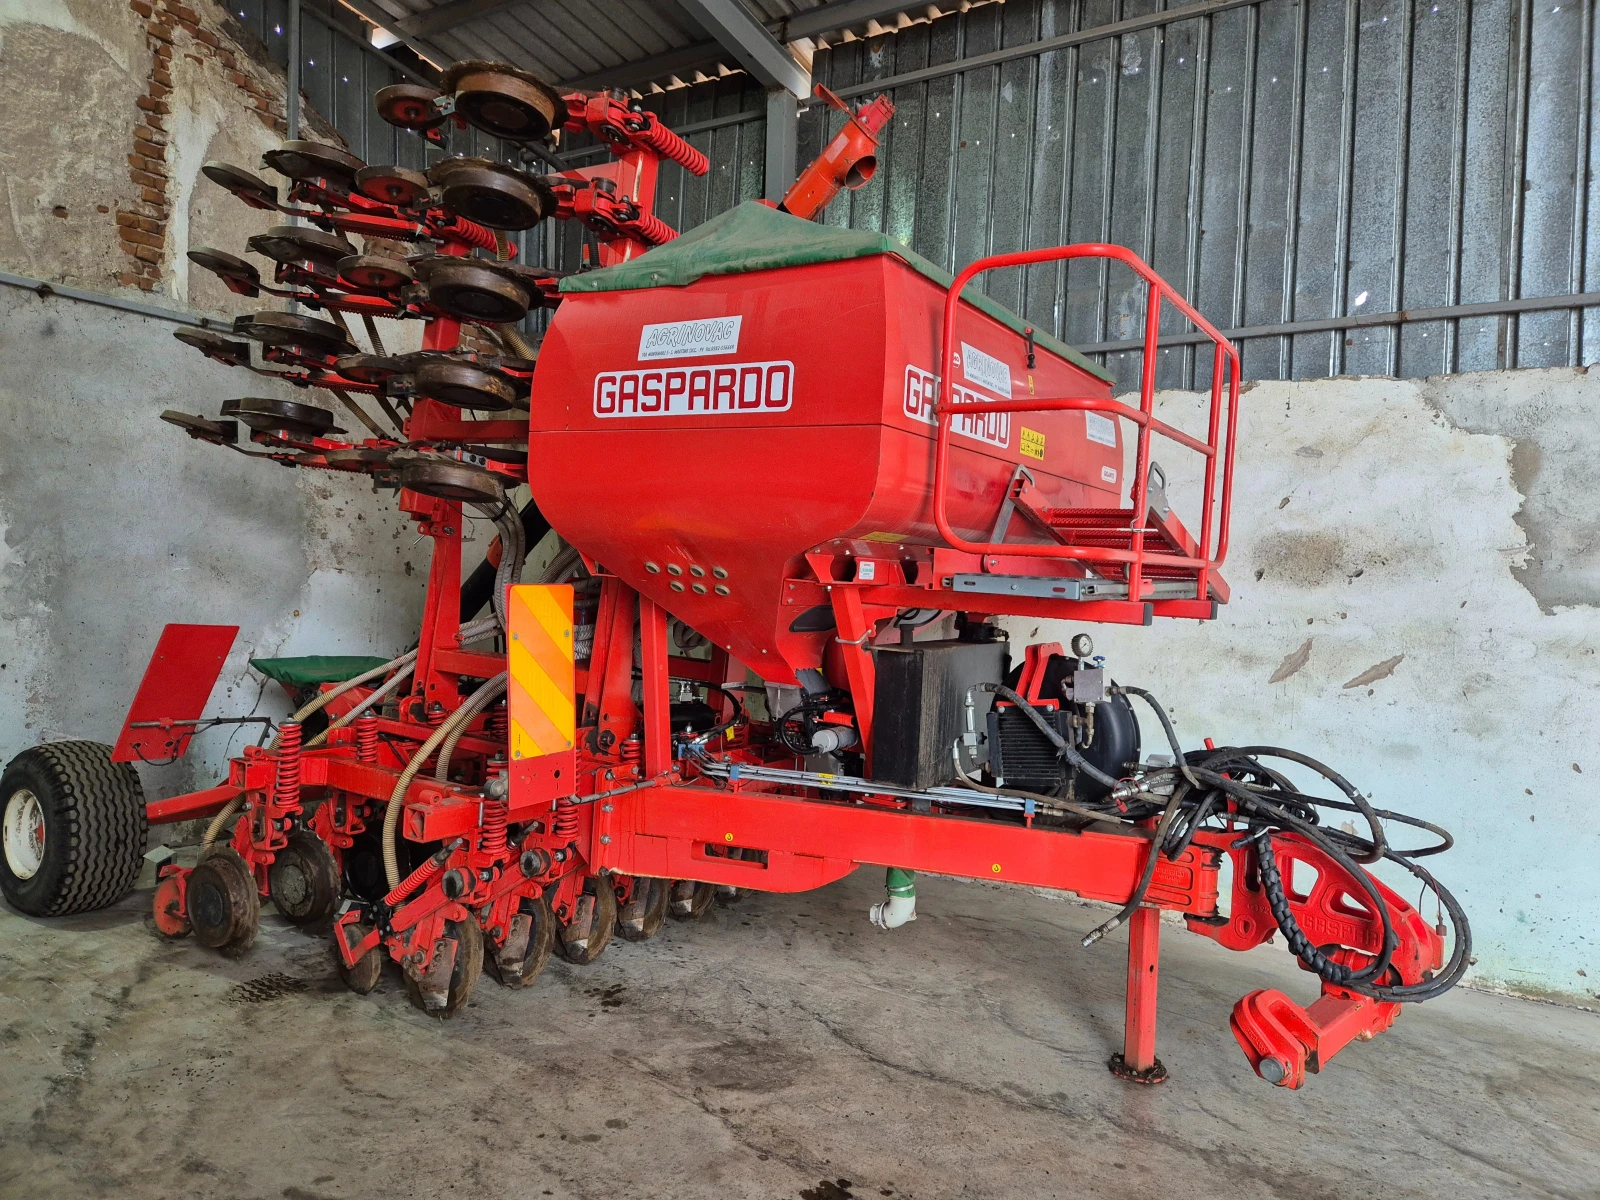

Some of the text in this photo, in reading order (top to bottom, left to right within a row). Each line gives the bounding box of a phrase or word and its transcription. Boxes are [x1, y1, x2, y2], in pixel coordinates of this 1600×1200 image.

[645, 320, 735, 349] AGRINOVAC
[596, 364, 790, 415] GASPARDO
[905, 368, 1009, 444] GAPARDO
